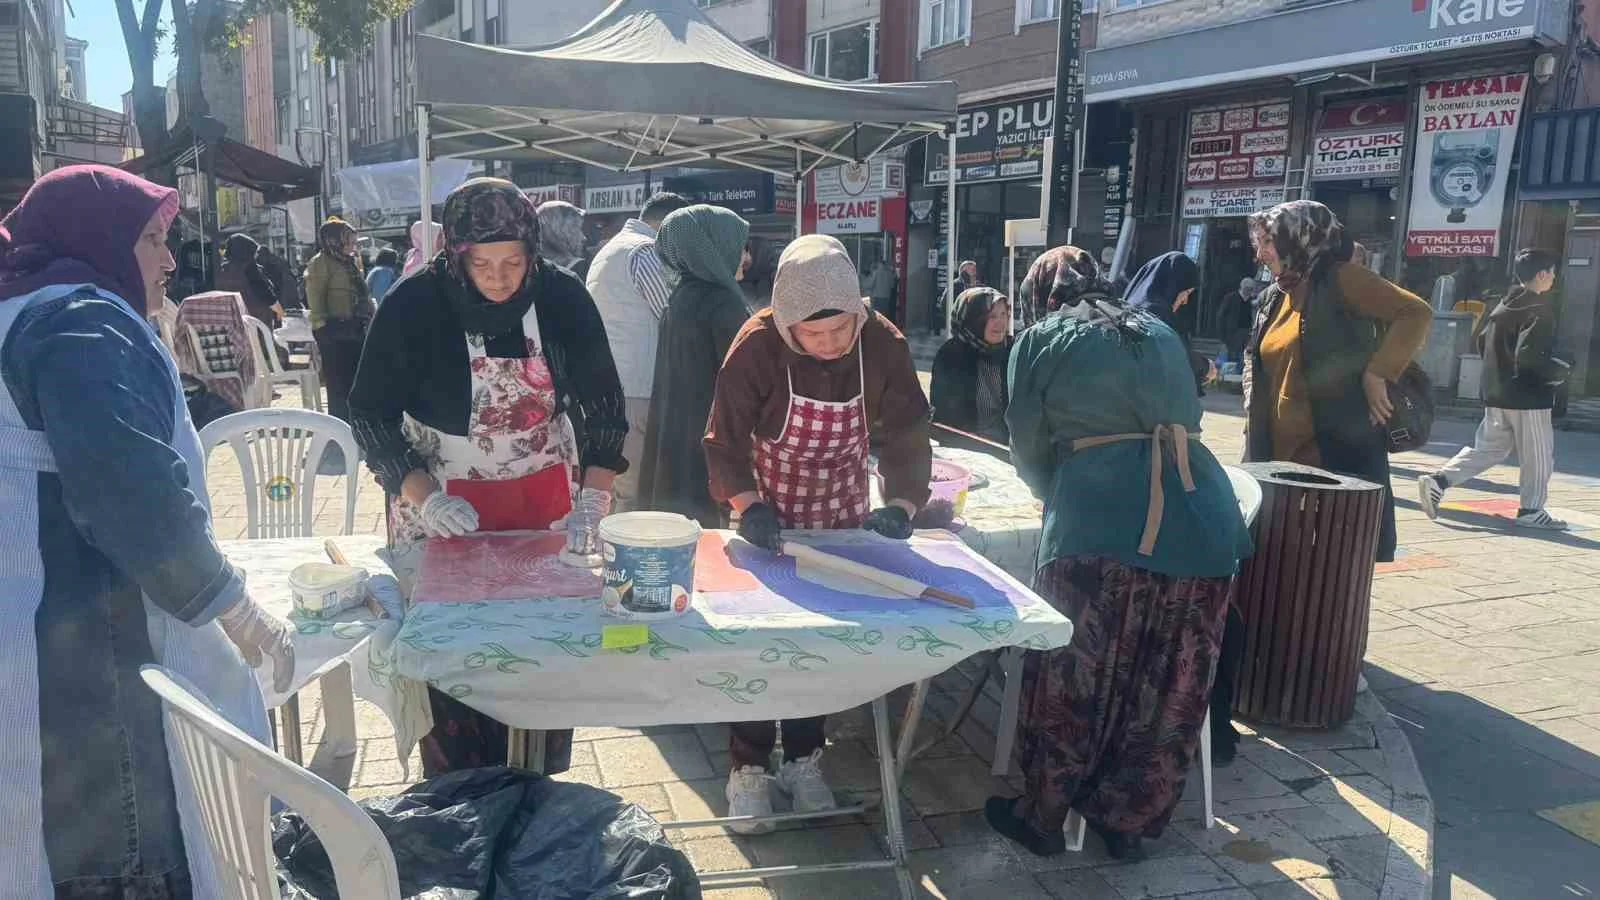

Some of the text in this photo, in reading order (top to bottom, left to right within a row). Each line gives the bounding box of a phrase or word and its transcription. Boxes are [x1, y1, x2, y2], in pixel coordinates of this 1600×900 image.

[1426, 76, 1525, 99] TEKSAN
[1423, 110, 1516, 132] BAYLAN
[1318, 145, 1402, 162] TİCARET
[590, 191, 623, 209] ARSLAN
[725, 189, 756, 200] Telekom
[818, 200, 877, 220] ECZANE
[1409, 233, 1495, 244] YETKİLİ SATI
[1421, 244, 1487, 254] NOKTASI
